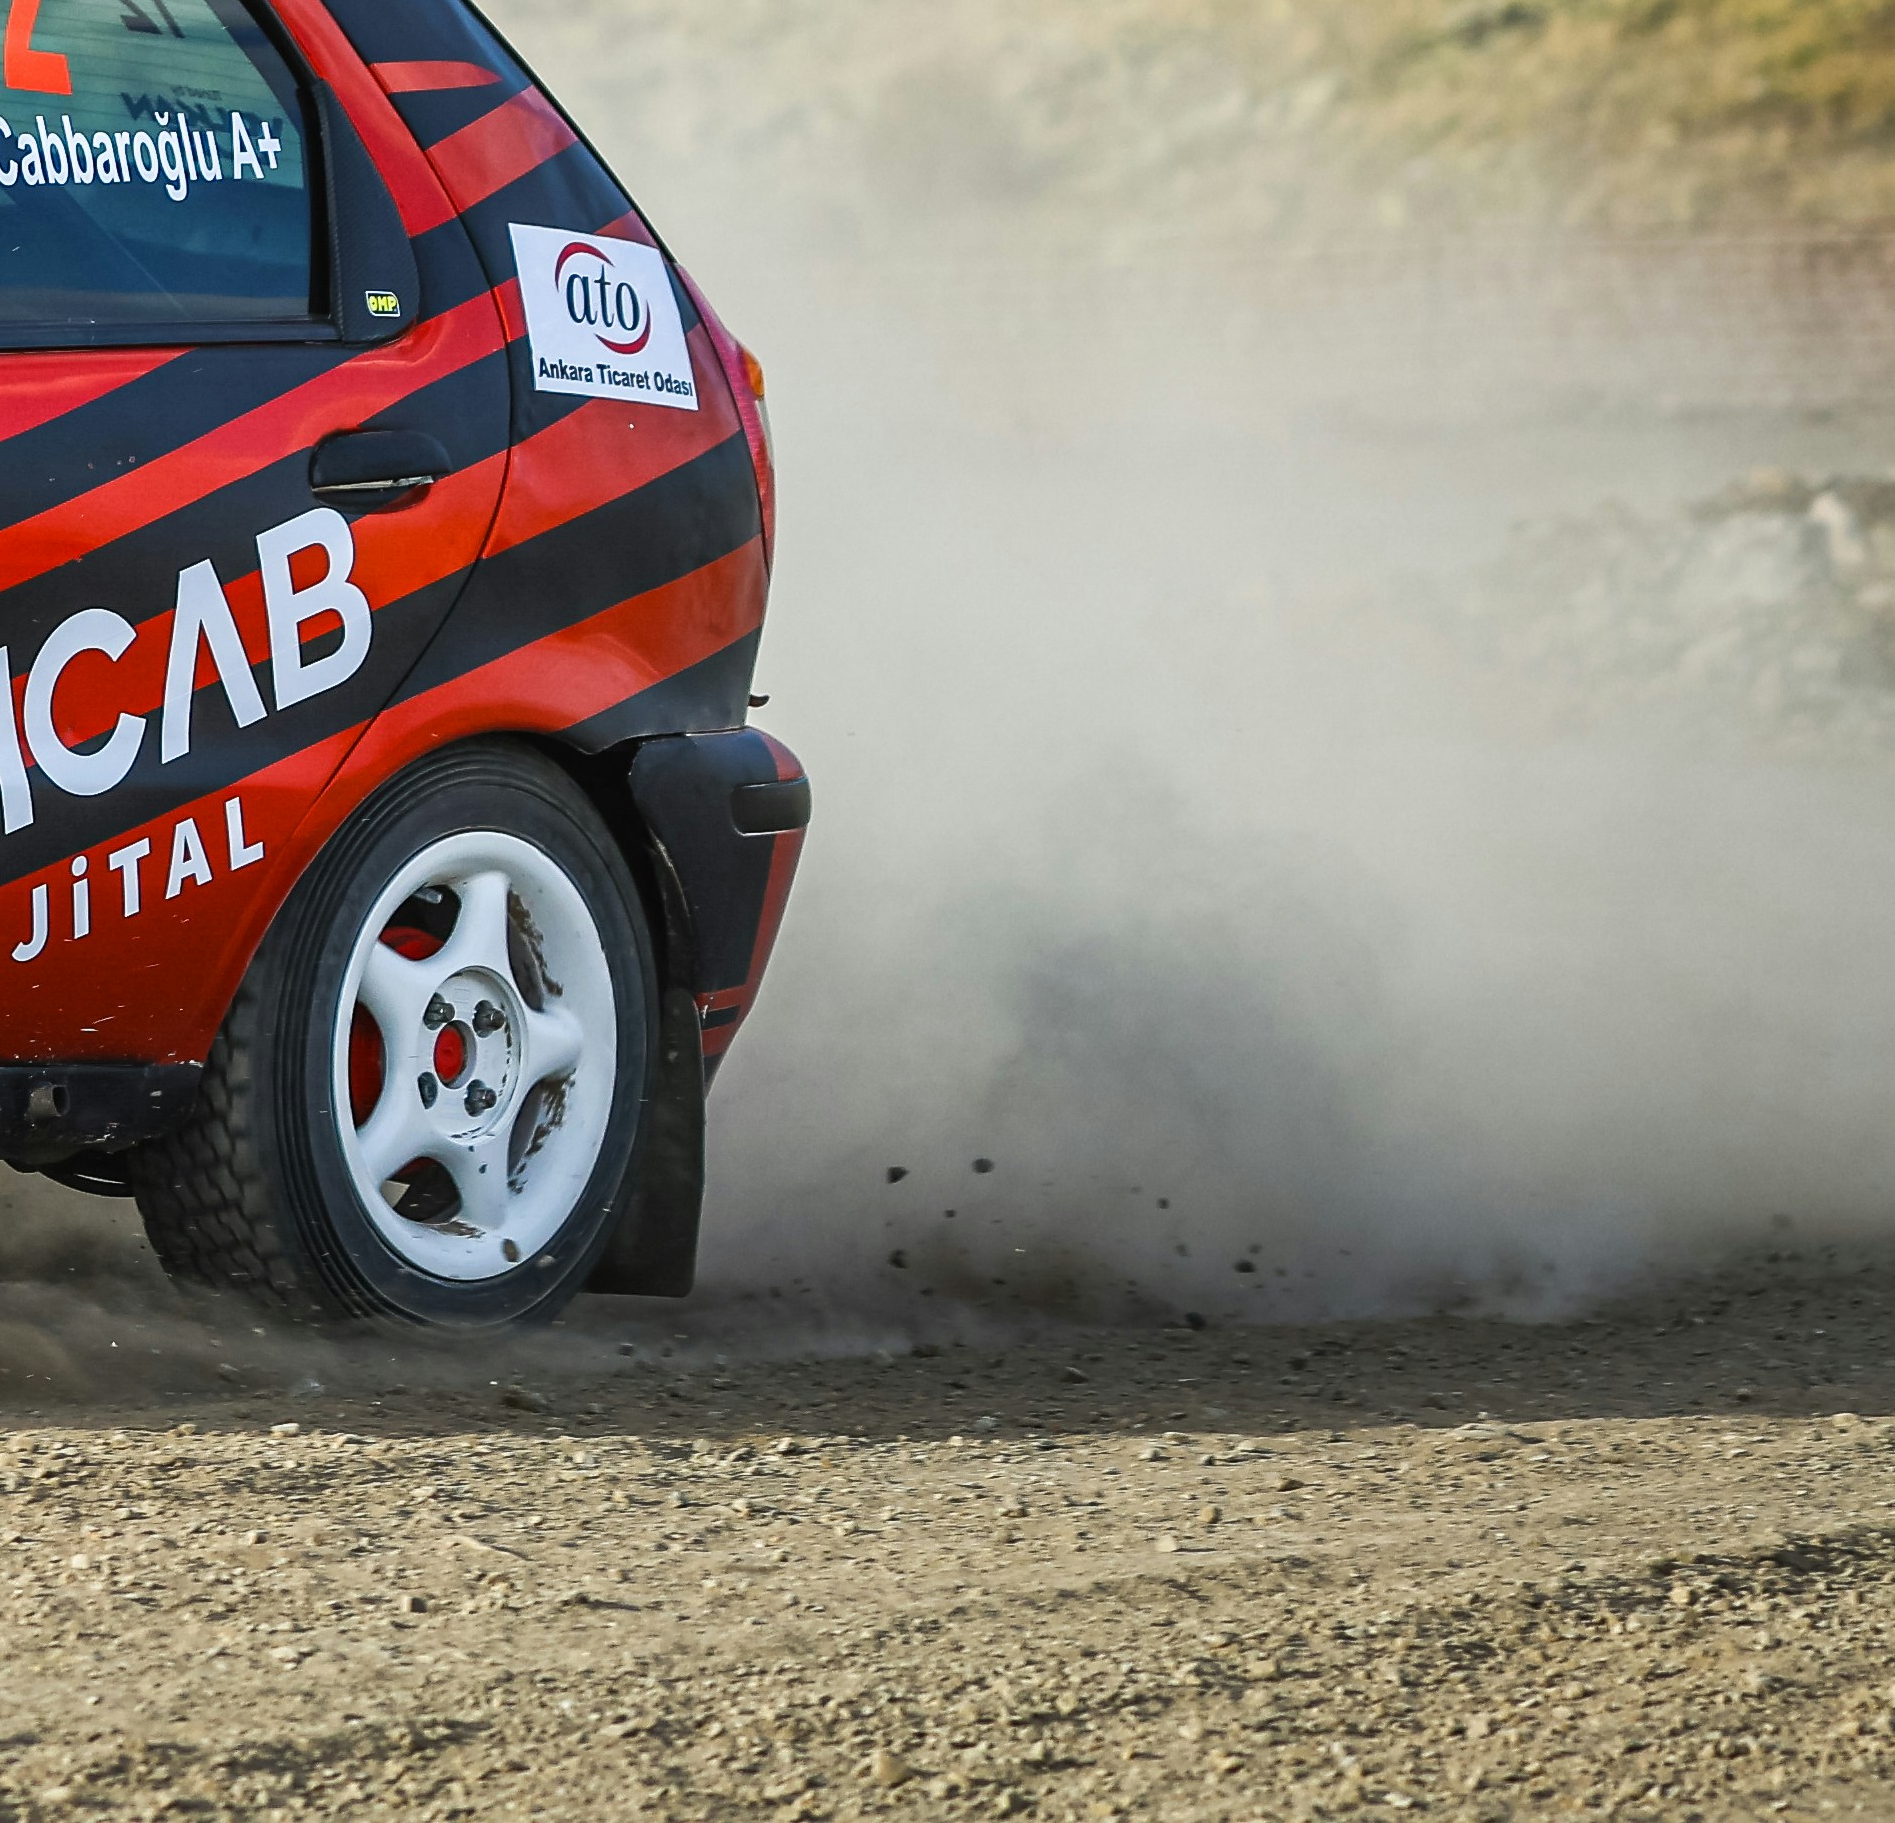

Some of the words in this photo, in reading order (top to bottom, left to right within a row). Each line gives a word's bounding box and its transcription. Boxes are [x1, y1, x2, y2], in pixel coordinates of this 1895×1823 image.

[231, 110, 283, 182] A+
[368, 295, 398, 312] OMP
[566, 263, 641, 332] ato
[538, 356, 594, 384] Ankara
[595, 363, 651, 391] Ticaret
[653, 370, 694, 397] Odası
